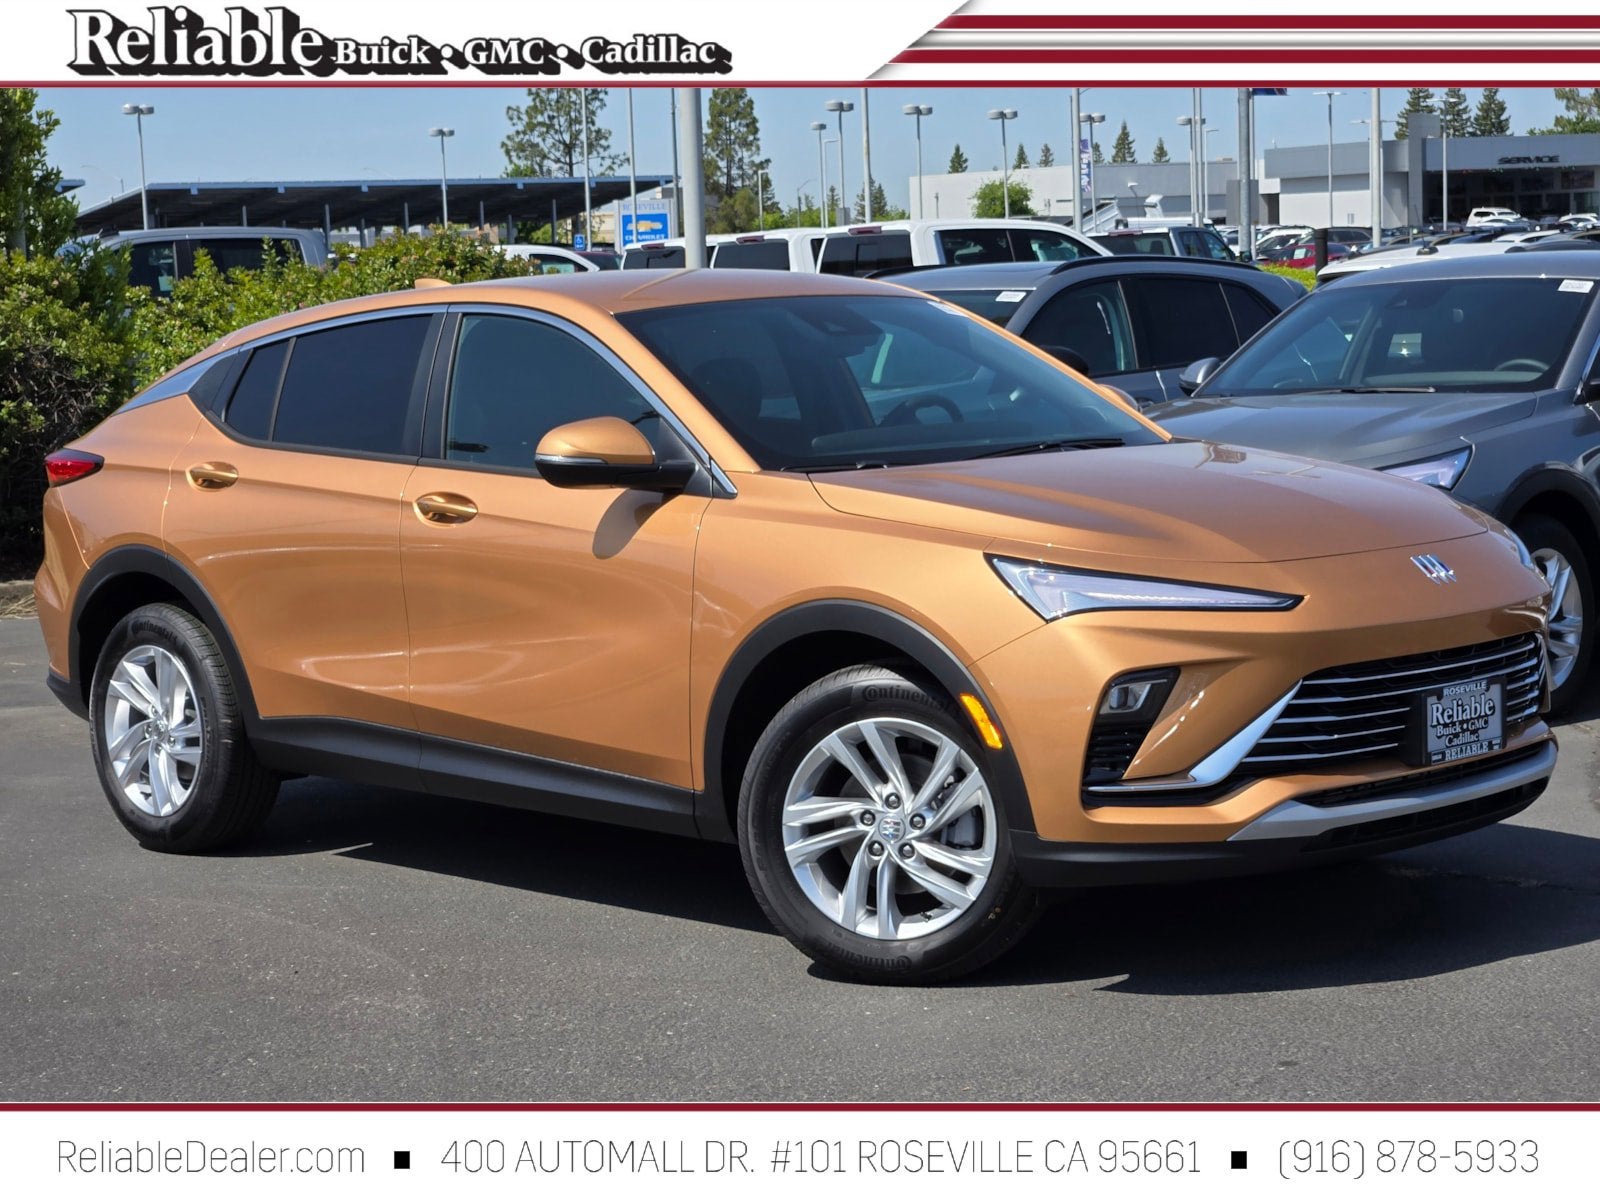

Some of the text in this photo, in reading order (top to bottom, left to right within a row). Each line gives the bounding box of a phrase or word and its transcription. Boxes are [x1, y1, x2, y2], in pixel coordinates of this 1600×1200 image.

[1498, 156, 1560, 164] SERVICE
[1443, 681, 1488, 697] ROSEVILLE
[1431, 693, 1496, 727] Reliable
[1436, 716, 1489, 739] Buick GMC
[1445, 732, 1480, 748] Cadillac
[1444, 741, 1490, 761] RELIABLE
